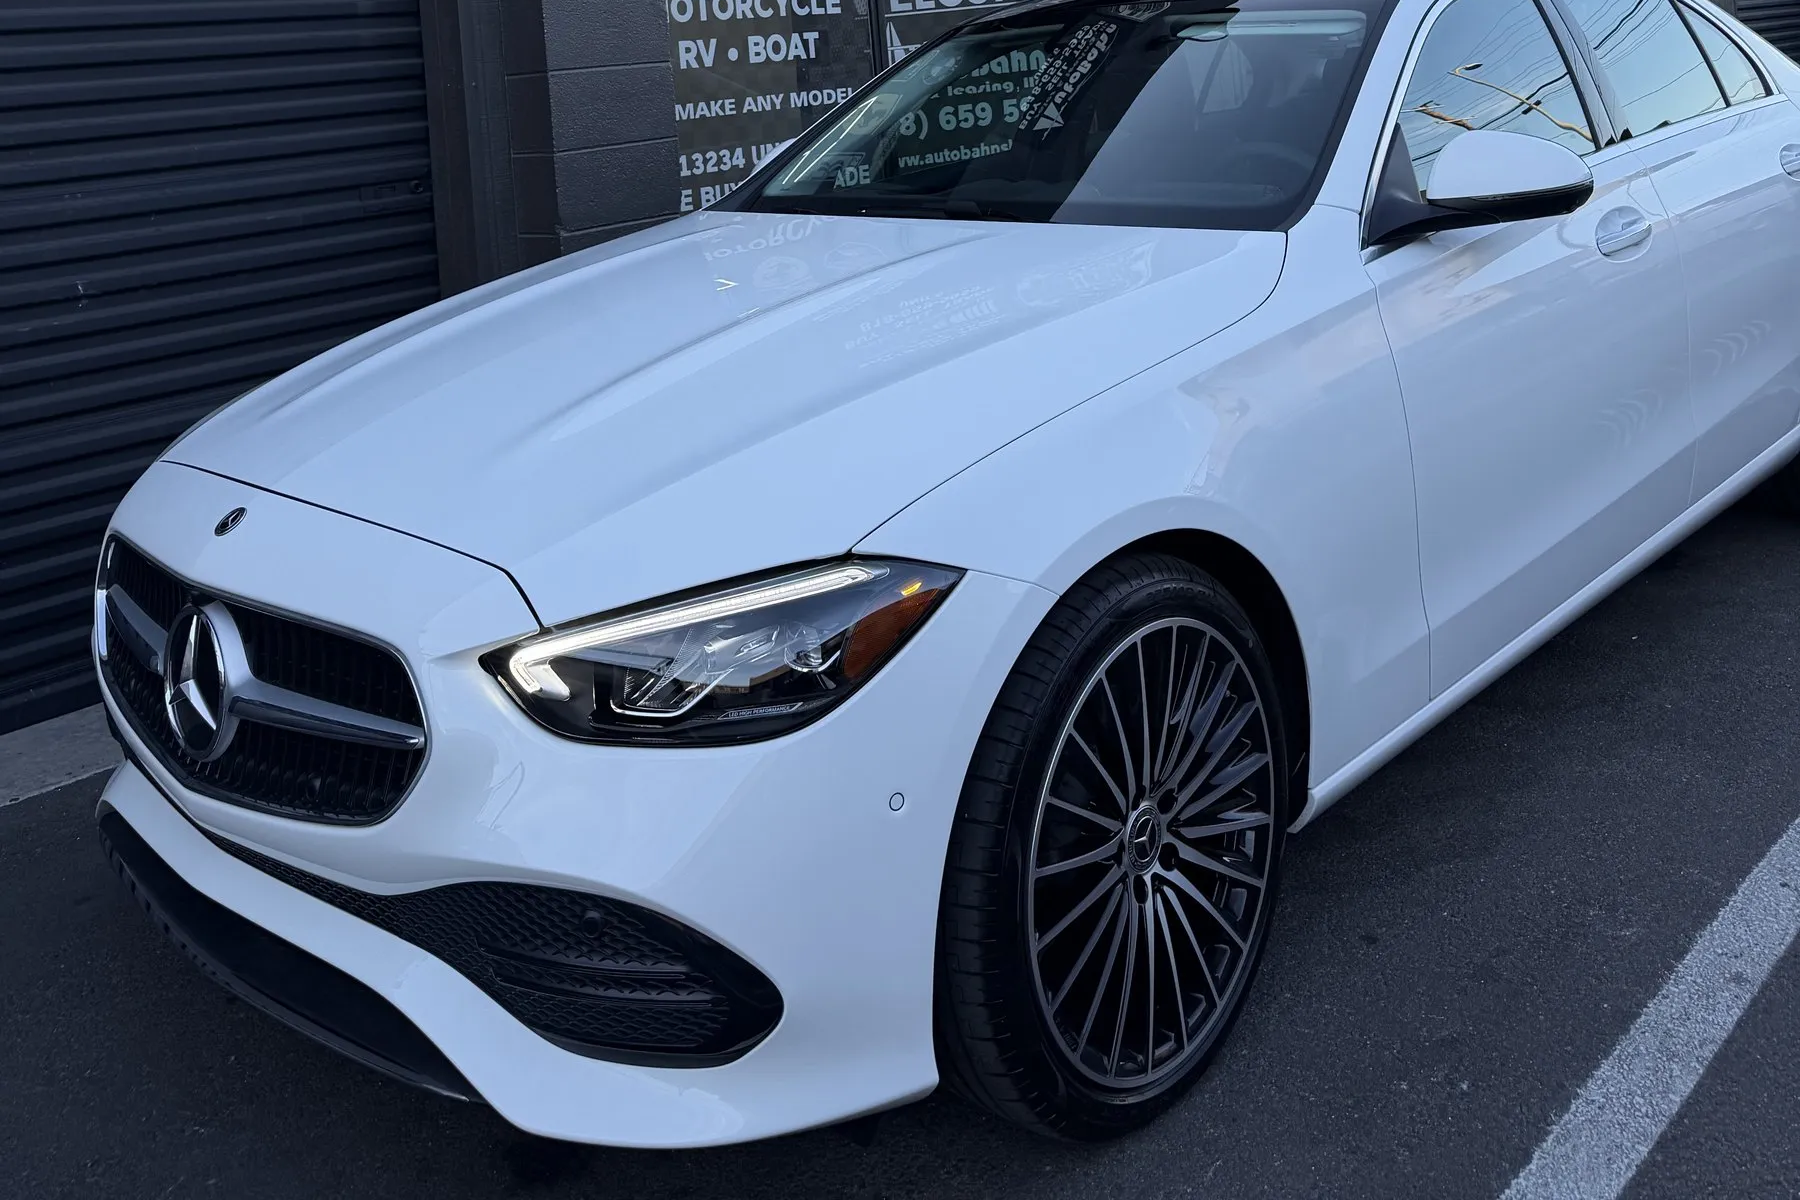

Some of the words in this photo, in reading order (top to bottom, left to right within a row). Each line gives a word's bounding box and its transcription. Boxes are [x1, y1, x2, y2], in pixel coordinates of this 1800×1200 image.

[678, 38, 717, 70] RV
[747, 31, 820, 64] BOAT
[674, 98, 737, 121] MAKE
[742, 93, 784, 113] ANY
[938, 101, 993, 131] 659
[679, 147, 746, 177] 13234
